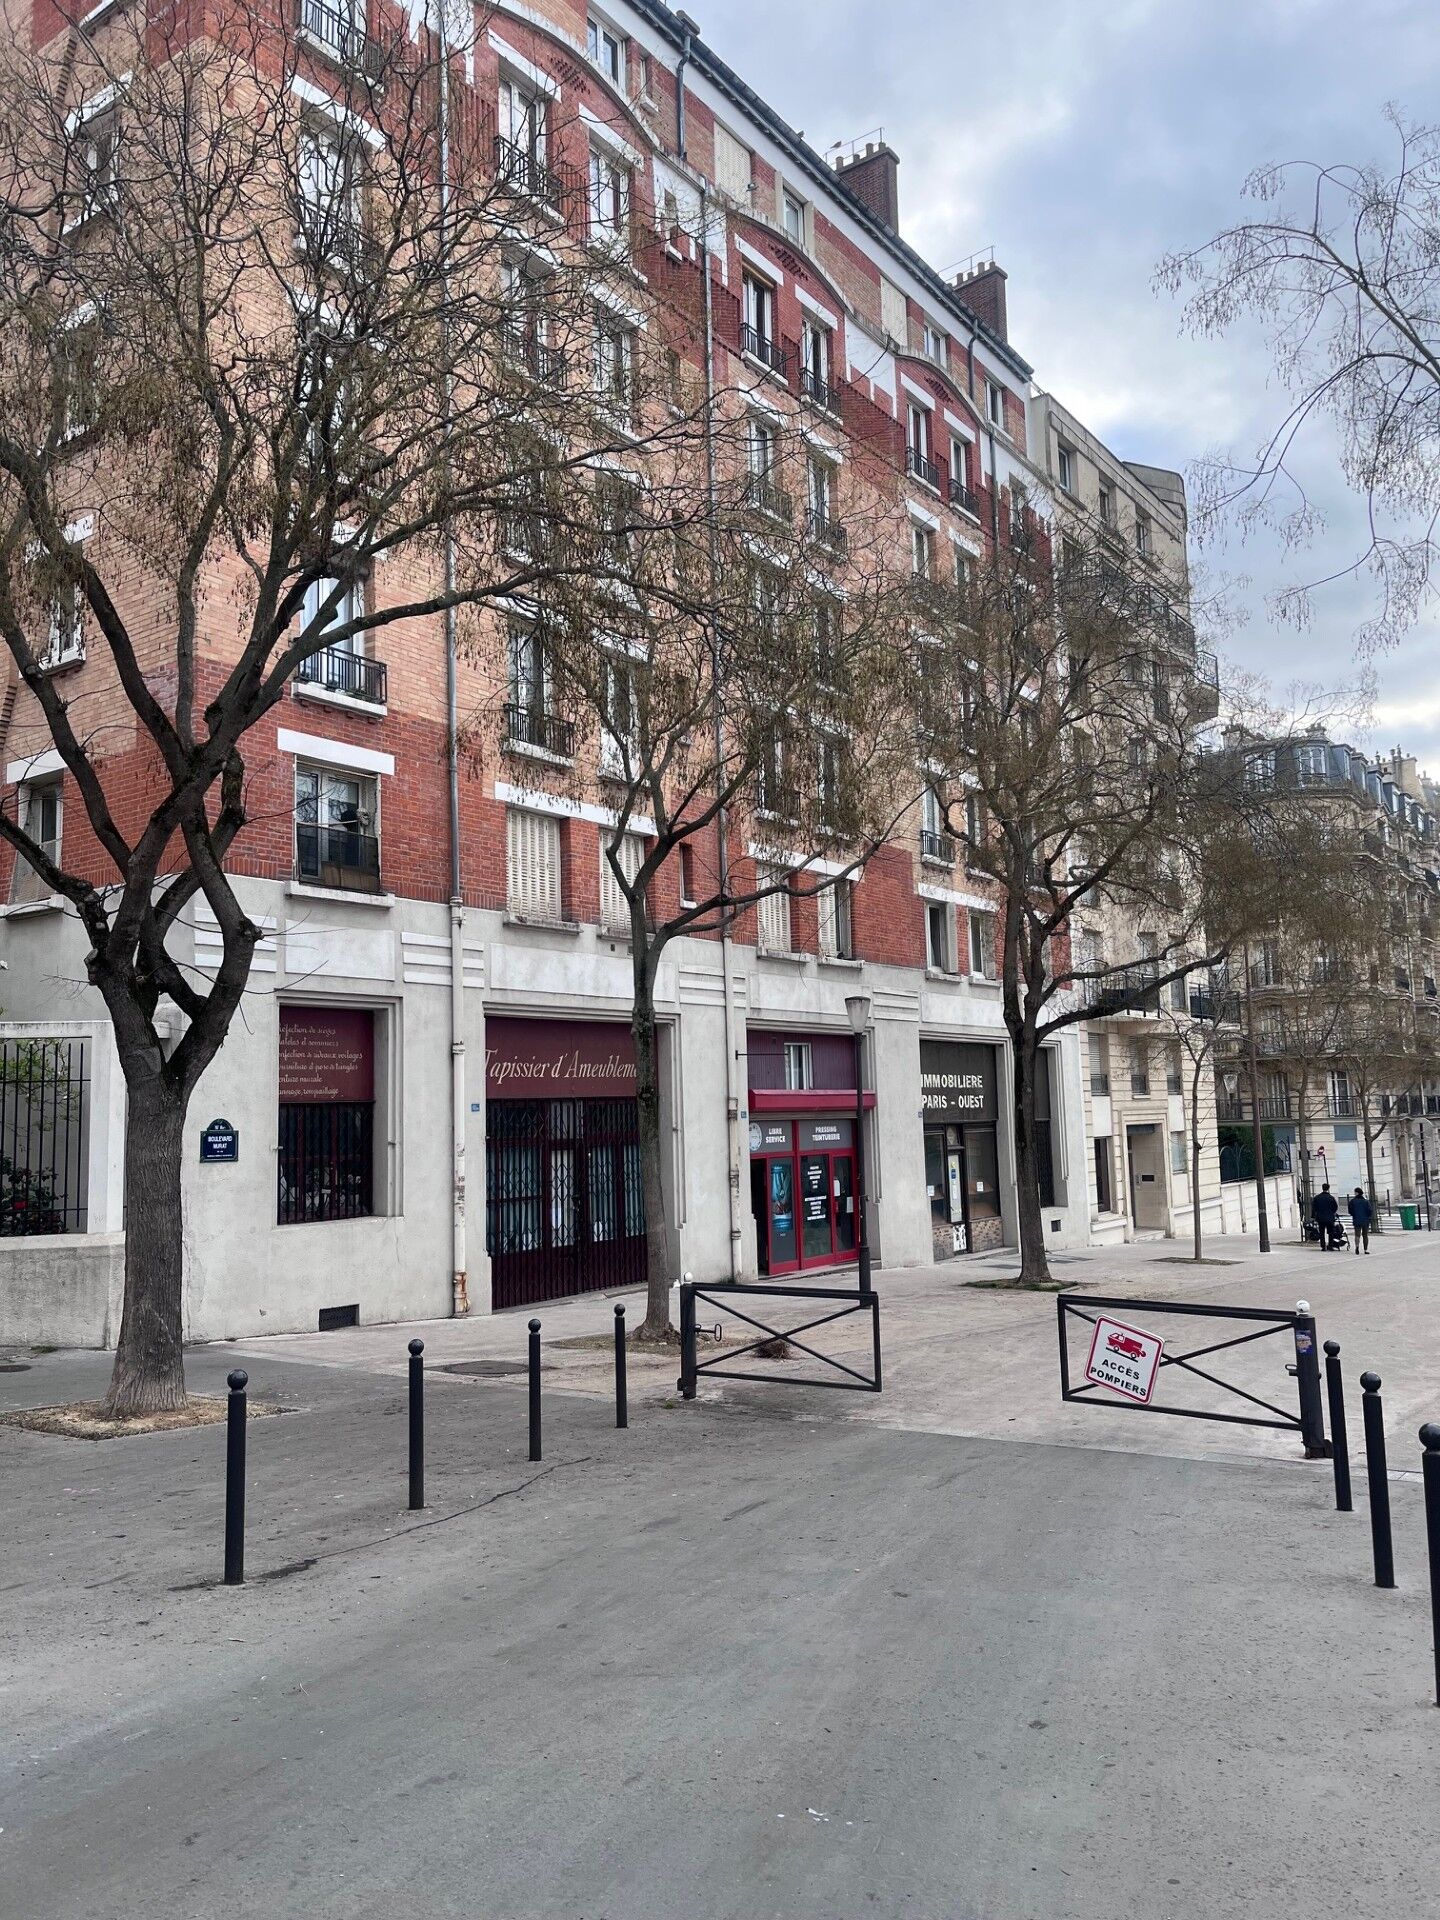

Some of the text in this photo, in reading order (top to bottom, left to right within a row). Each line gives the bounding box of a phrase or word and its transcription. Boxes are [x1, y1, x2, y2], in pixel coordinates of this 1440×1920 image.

[485, 1049, 550, 1085] Tapissier
[920, 1073, 983, 1088] IMMOBILIERE
[921, 1094, 948, 1109] PARIS
[958, 1094, 984, 1109] OUEST
[768, 1127, 782, 1135] LIBRE
[815, 1125, 837, 1133] PRESSING
[765, 1135, 786, 1143] SERVICE
[1101, 1358, 1140, 1380] ACCÈS
[1090, 1366, 1147, 1396] POMPIERS
